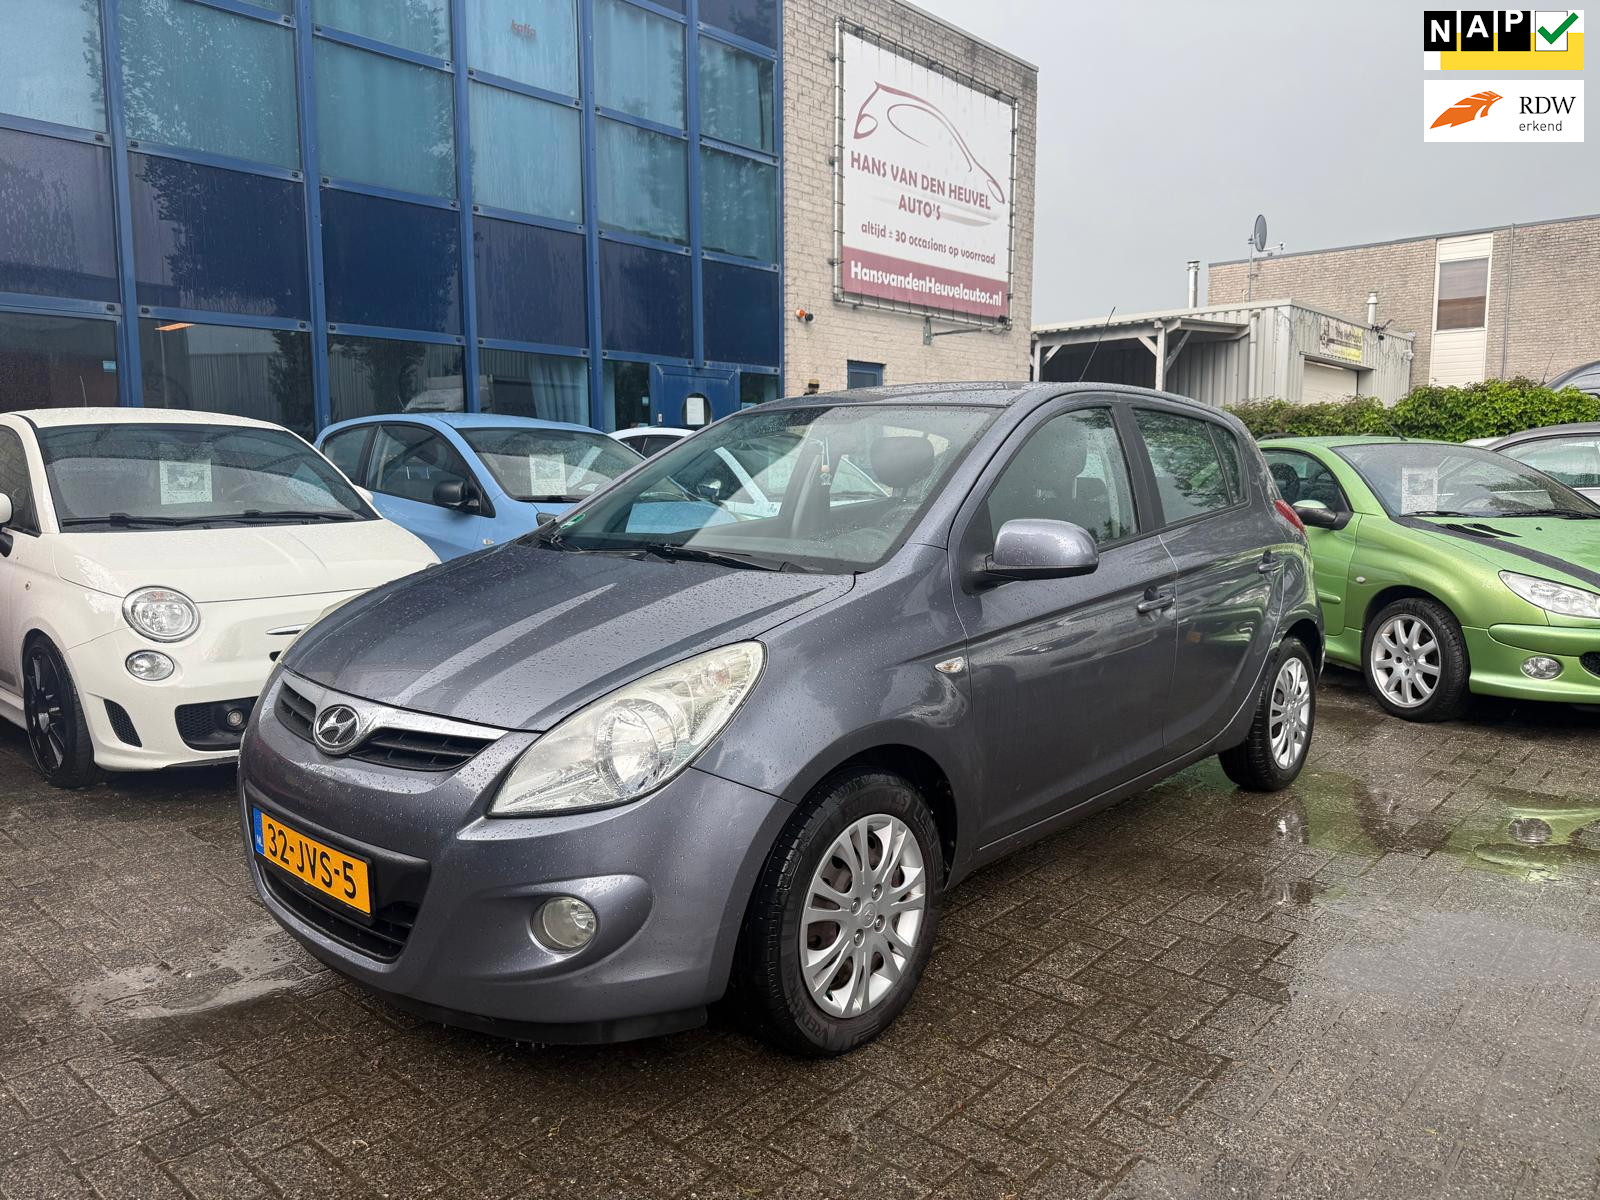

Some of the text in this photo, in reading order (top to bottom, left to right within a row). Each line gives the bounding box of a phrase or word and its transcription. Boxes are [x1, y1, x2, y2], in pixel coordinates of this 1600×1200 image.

[850, 150, 990, 209] HANS VAN DEN HEUVEL
[898, 194, 941, 220] AUTO'S
[861, 221, 886, 239] altijd
[895, 230, 907, 243] 30
[909, 234, 947, 254] occasions
[948, 245, 959, 257] op
[961, 248, 996, 265] voorraad
[851, 260, 1002, 306] HansvandenHeuvelautos.nl
[267, 823, 357, 899] 32-JVS-5
